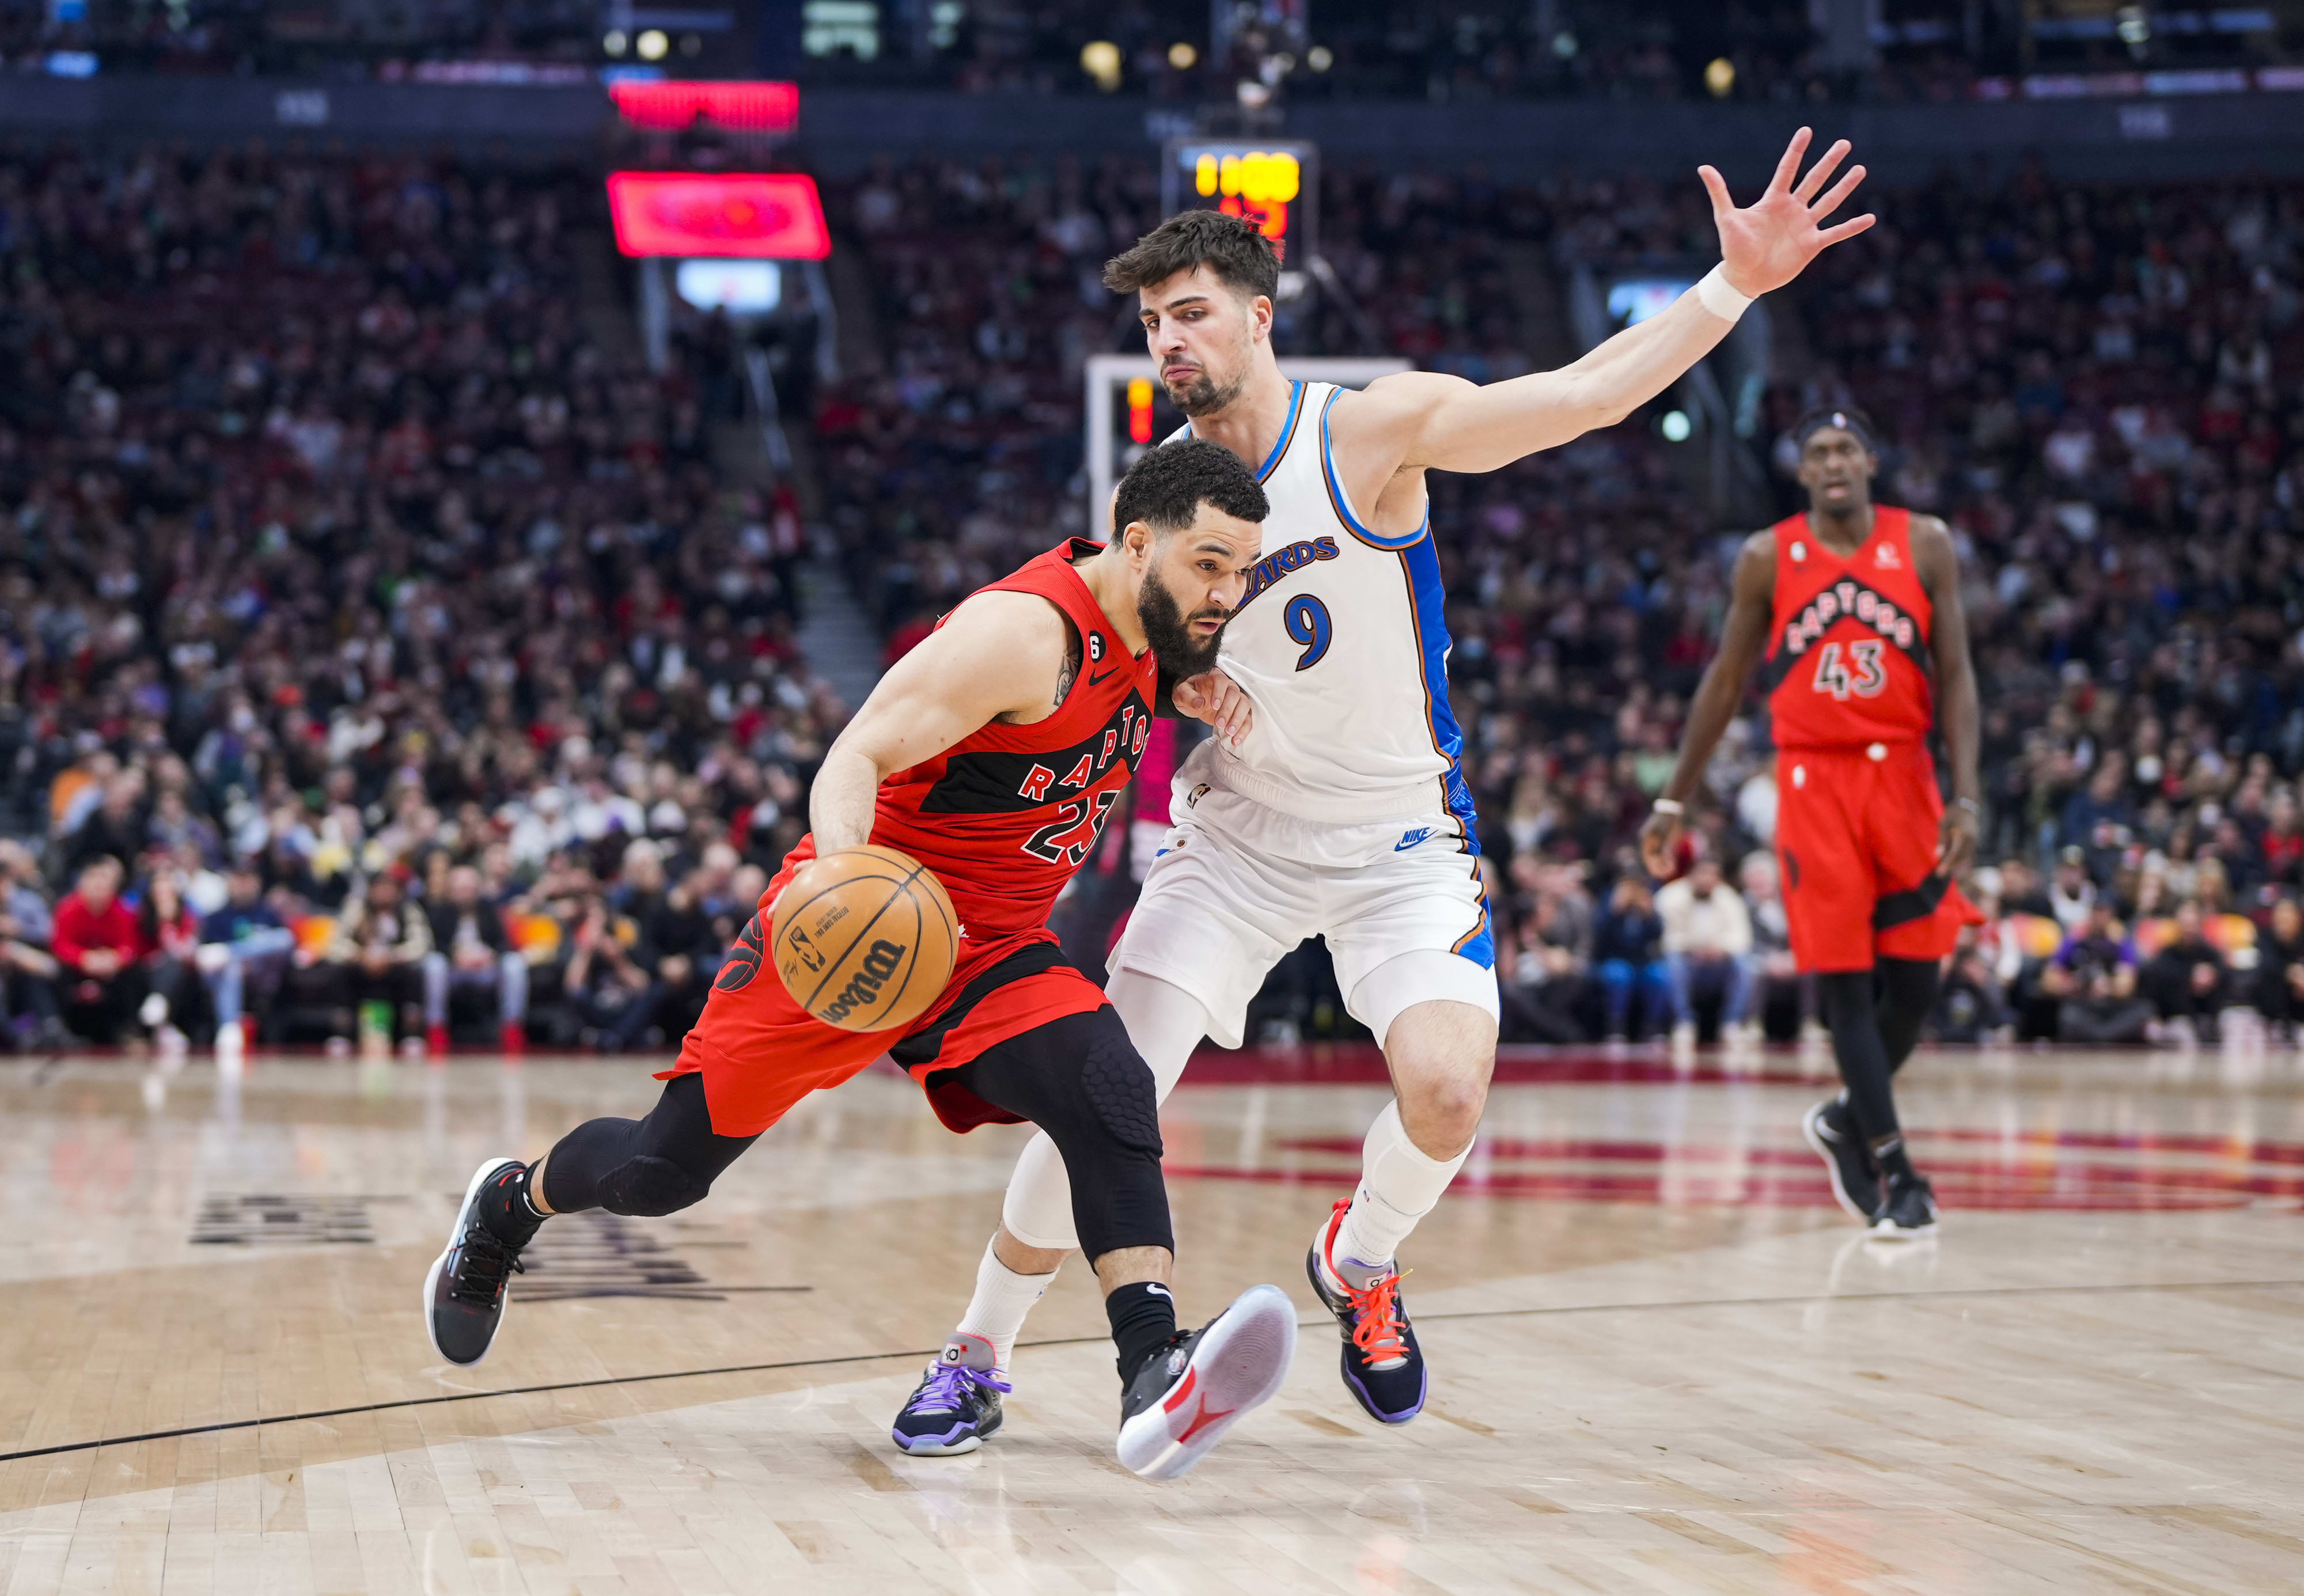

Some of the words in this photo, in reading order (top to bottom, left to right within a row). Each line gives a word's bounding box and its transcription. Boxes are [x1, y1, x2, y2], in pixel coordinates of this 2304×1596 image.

[1090, 635, 1100, 659] 6
[1283, 593, 1332, 672] 9
[1787, 582, 1913, 654] RAPTORS
[1813, 639, 1888, 701] 43
[1017, 704, 1150, 802] RAPTO
[1020, 789, 1121, 866] 23
[1400, 827, 1430, 844] NIKE
[831, 906, 849, 923] OFFICIAL
[817, 939, 907, 1023] Wilson
